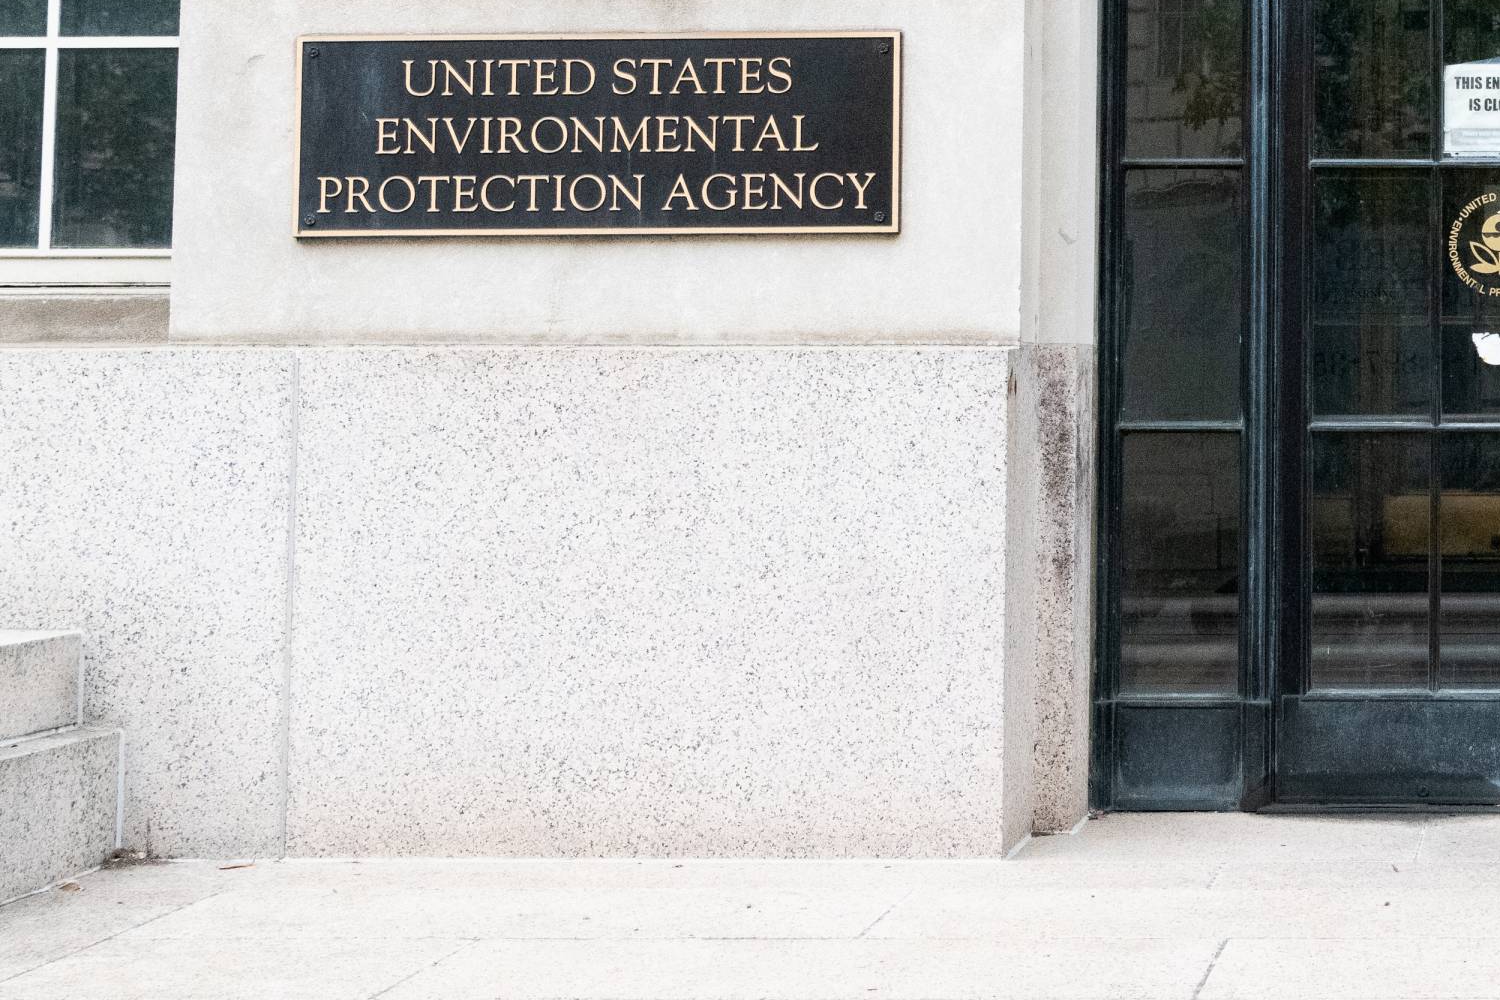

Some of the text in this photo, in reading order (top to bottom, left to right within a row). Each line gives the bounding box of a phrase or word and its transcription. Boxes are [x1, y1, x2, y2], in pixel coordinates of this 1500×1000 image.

[402, 57, 793, 97] UNITED STATES
[1454, 76, 1482, 90] THIS
[1468, 98, 1481, 111] IS
[374, 115, 819, 155] ENVIRONMENTAL
[317, 172, 877, 214] PROTECTION AGENCY
[1459, 192, 1497, 219] UNITED
[1448, 220, 1486, 295] ENVIRONMENTL
